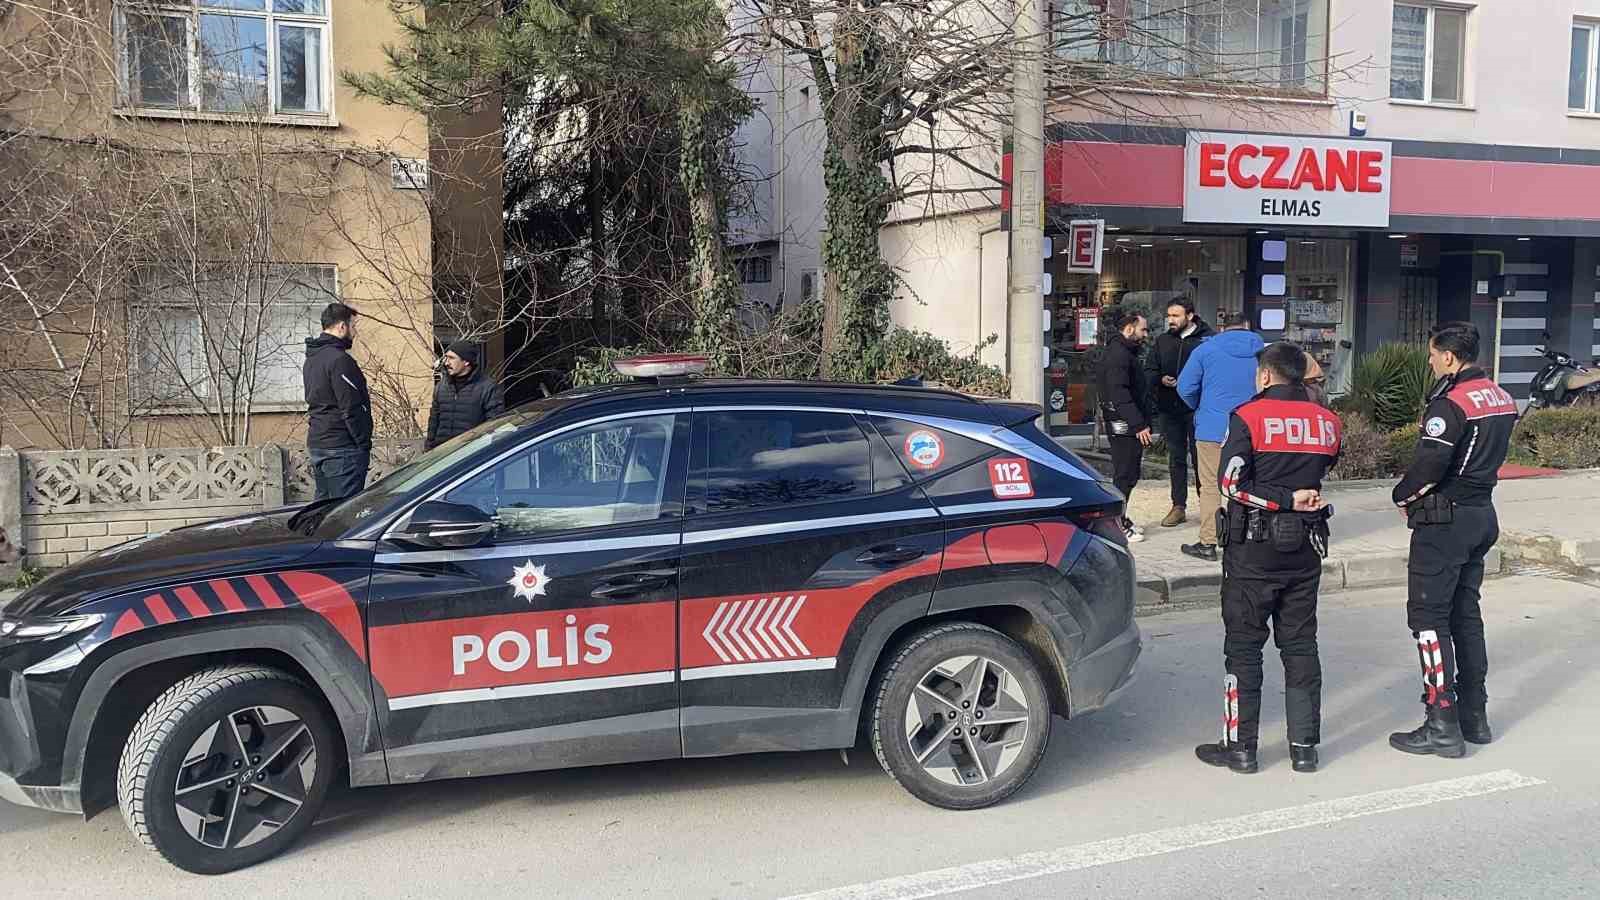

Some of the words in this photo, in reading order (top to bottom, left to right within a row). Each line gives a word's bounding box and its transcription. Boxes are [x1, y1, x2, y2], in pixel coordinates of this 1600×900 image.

[1199, 142, 1384, 194] ECZANE
[1261, 198, 1322, 217] ELMAS
[1075, 230, 1093, 263] E
[1263, 414, 1337, 448] POLİS
[994, 462, 1024, 482] 112
[452, 614, 613, 676] POLİS
